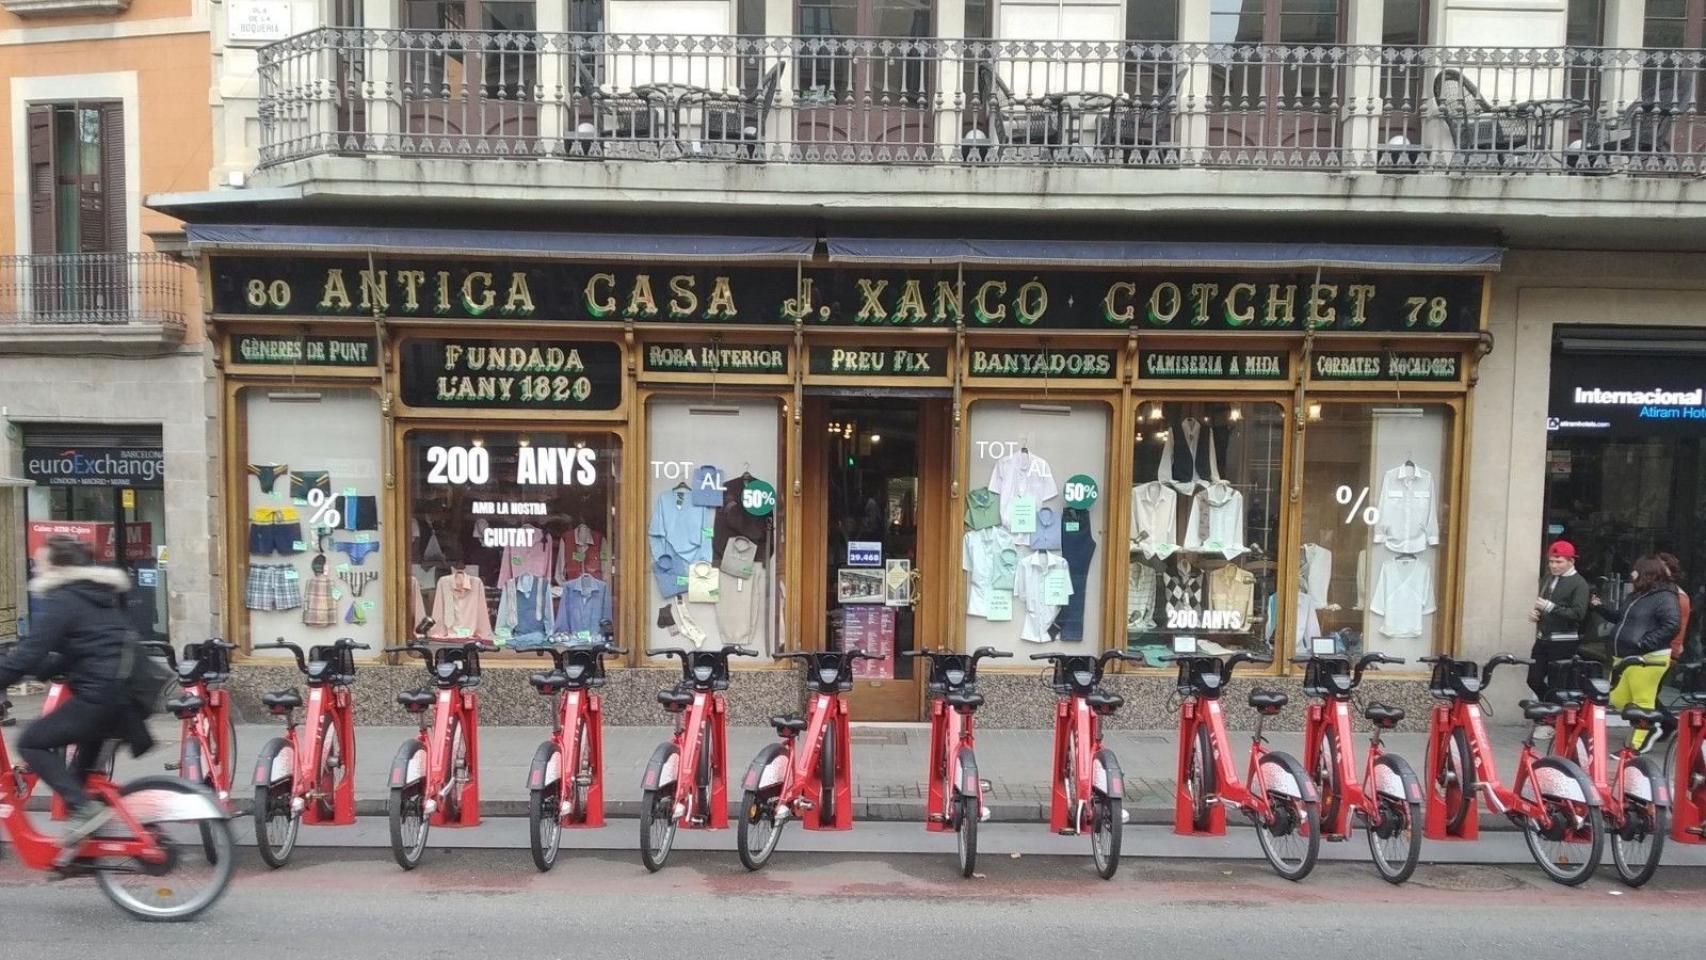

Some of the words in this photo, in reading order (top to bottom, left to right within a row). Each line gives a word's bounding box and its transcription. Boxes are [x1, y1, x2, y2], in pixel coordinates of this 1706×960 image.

[248, 279, 291, 307] 80
[317, 268, 536, 315] ANTIGA
[584, 272, 738, 318] CASA
[782, 278, 831, 321] J.
[855, 276, 1048, 324] XANCÓ
[1102, 282, 1376, 326] COTCHET
[1406, 296, 1448, 326] 78
[307, 341, 325, 361] DE
[329, 340, 368, 361] PUNT
[445, 344, 585, 372] FUNDADA
[649, 346, 697, 366] ROBA
[701, 347, 783, 367] INTERIOR
[831, 349, 885, 372] PREU
[893, 350, 930, 372] FIX
[973, 350, 1111, 374] BANYADORS
[1147, 354, 1223, 375] CAMISERIA
[1229, 356, 1239, 375] A
[1245, 356, 1280, 375] MIDA
[1316, 356, 1380, 376] CORBATES
[437, 376, 515, 401] L'ANY
[518, 375, 592, 401] 1820
[1575, 387, 1702, 405] Internacional
[1640, 406, 1679, 418] Atiram
[1683, 407, 1706, 418] Hot
[976, 441, 1018, 459] TOT
[29, 454, 164, 480] euroExchange
[427, 446, 489, 484] 200
[517, 447, 596, 485] ANYS
[651, 461, 693, 479] TOT
[701, 473, 727, 491] AL
[1065, 482, 1097, 500] 50%
[307, 488, 340, 528] %
[472, 502, 494, 514] AMB
[497, 503, 509, 514] LA
[511, 503, 547, 515] NOSTRA
[743, 489, 775, 508] 50%
[1336, 485, 1379, 525] %
[484, 528, 535, 547] CIUTAT
[1167, 610, 1198, 628] 200
[1202, 610, 1241, 629] ANYS
